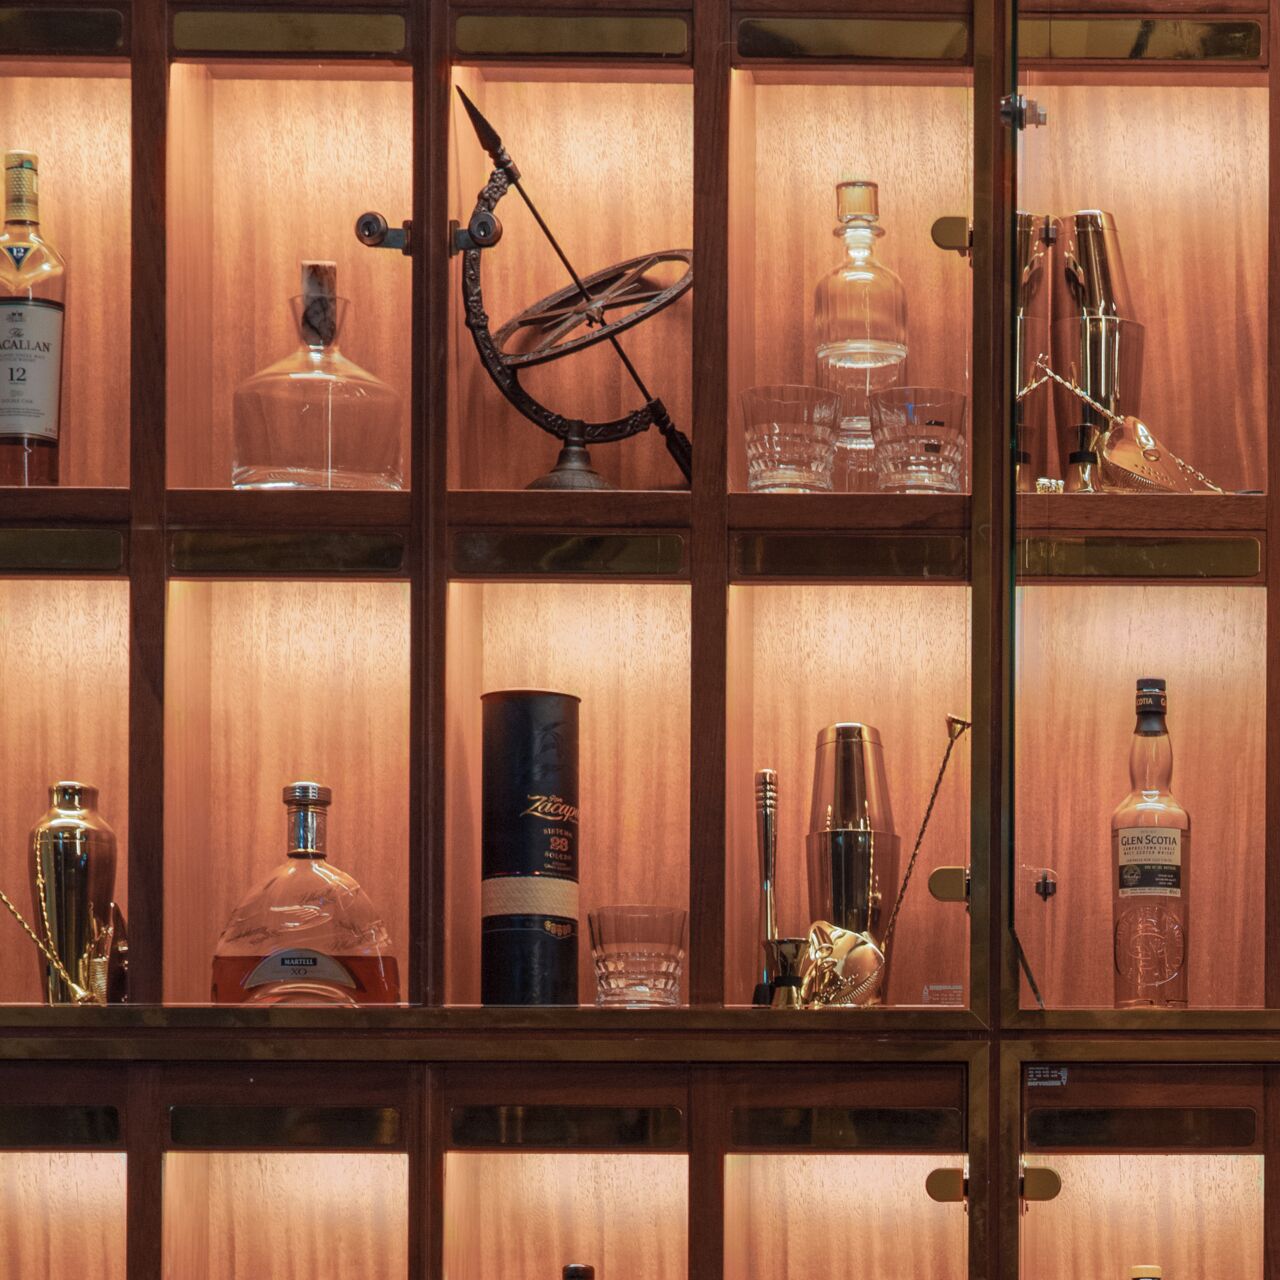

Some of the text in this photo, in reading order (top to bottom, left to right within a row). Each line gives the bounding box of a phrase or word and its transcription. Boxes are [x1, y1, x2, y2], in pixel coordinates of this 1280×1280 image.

[12, 247, 24, 257] 12
[8, 367, 27, 382] 12
[1121, 834, 1177, 846] GLEN SCOTIA
